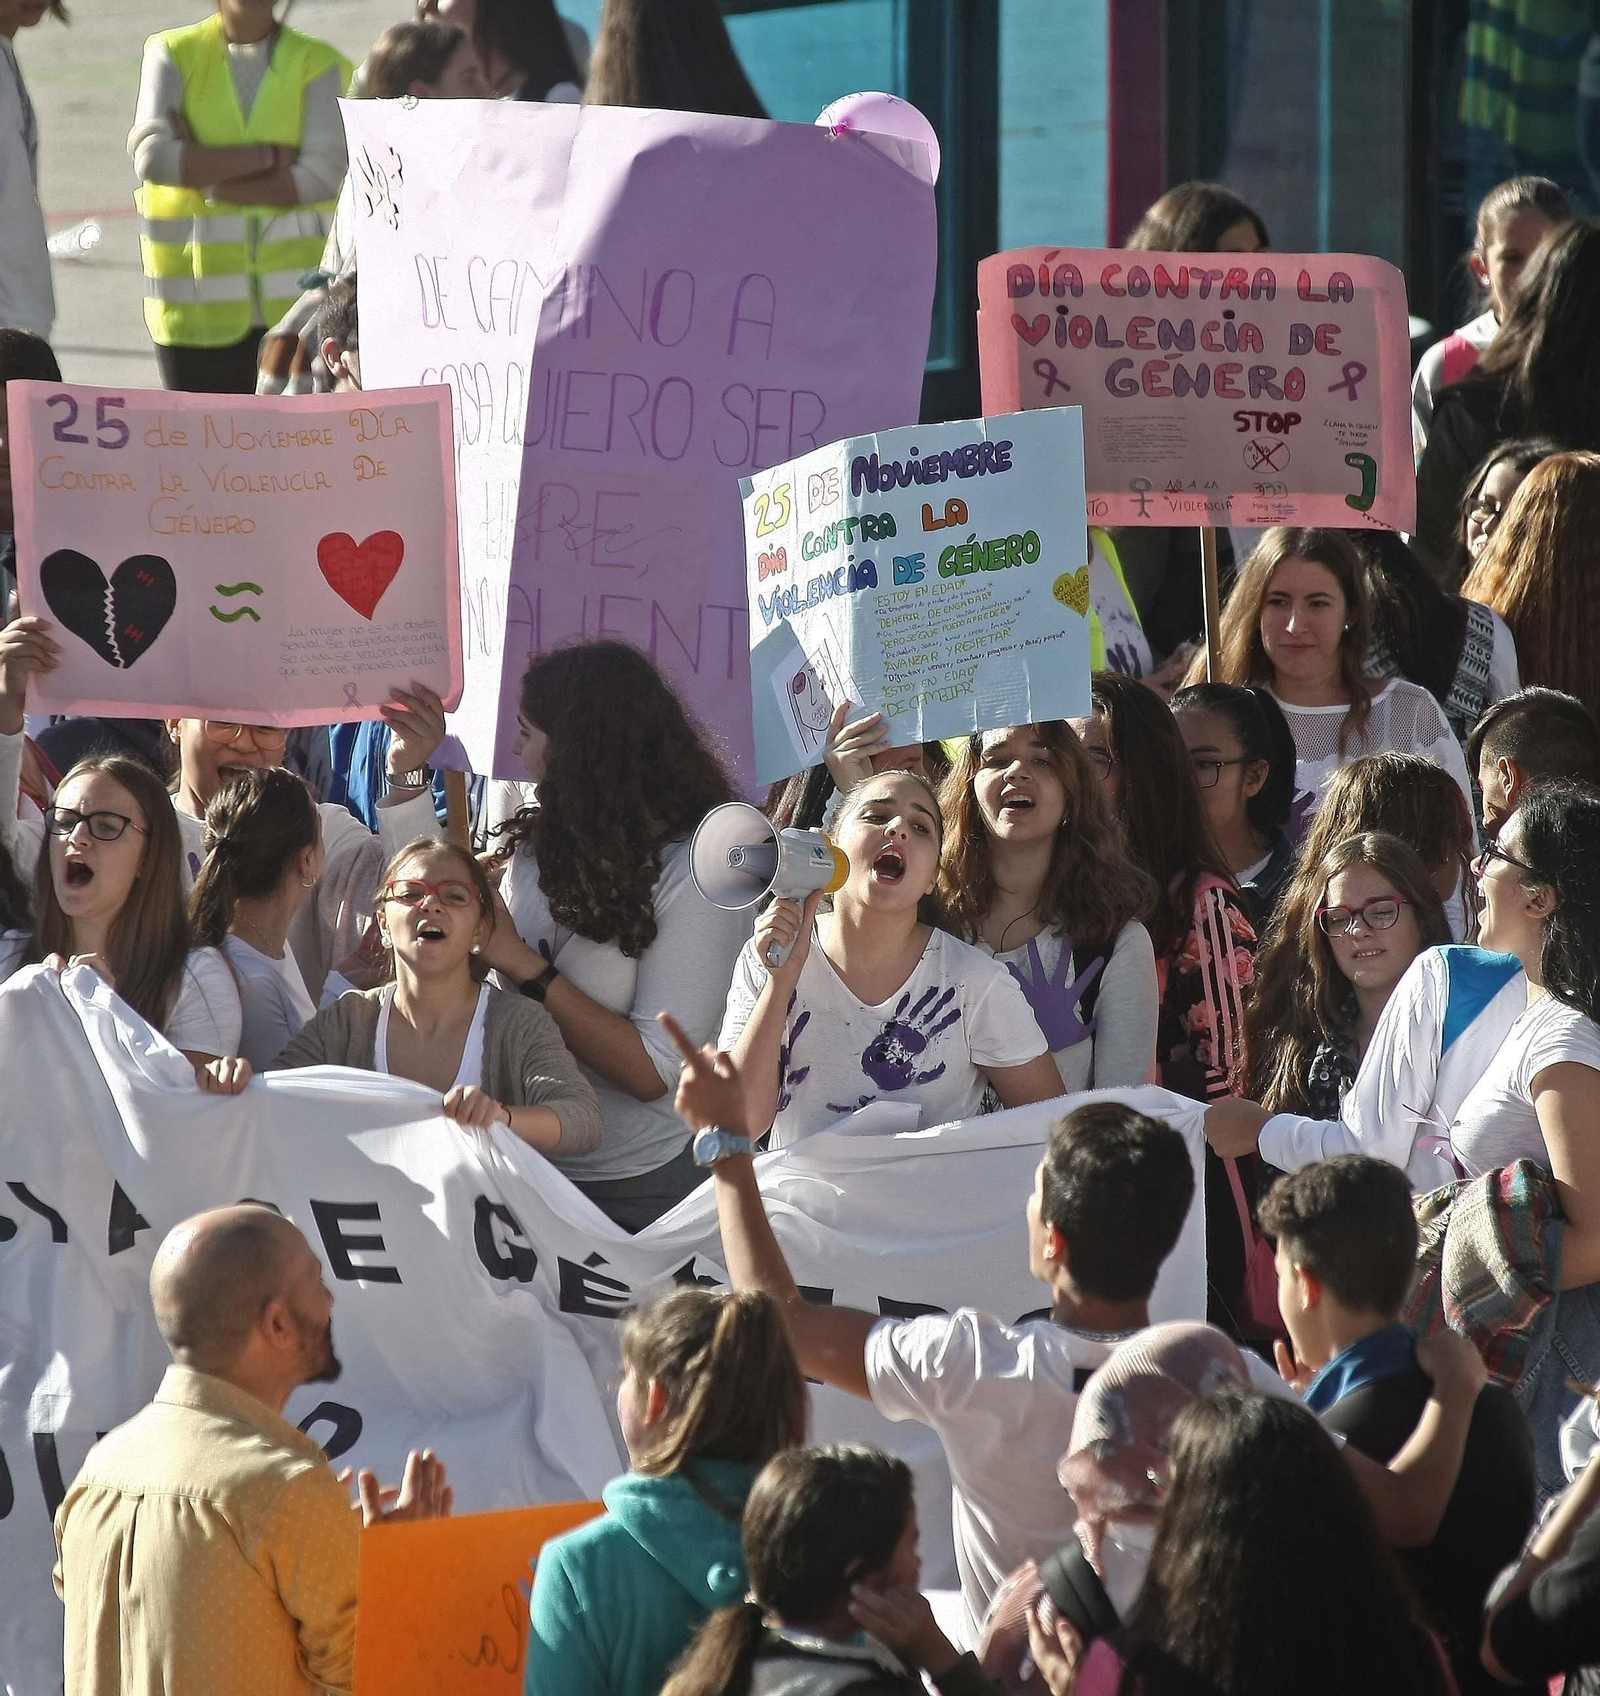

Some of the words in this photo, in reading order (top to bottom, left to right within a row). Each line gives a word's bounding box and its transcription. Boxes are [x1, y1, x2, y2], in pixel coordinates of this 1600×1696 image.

[1006, 250, 1084, 299] DÍA
[1100, 263, 1277, 301] CONTRA
[1297, 269, 1355, 303] LA
[414, 252, 457, 331] DE
[468, 255, 696, 348] CAMINO
[726, 273, 777, 360] A
[1288, 322, 1342, 357] DE
[1105, 353, 1307, 401] GÉNERO
[46, 393, 130, 449] 25
[143, 416, 189, 447] de
[503, 362, 695, 461] QUIERO
[713, 383, 827, 470] SER
[1233, 411, 1302, 434] STOP
[39, 455, 137, 491] CONTRA
[353, 455, 388, 482] DE
[754, 483, 791, 538] 25
[808, 467, 840, 513] DE
[850, 440, 1014, 497] NOVIEMBRE
[1167, 479, 1183, 490] NO
[1188, 481, 1197, 489] A
[147, 497, 256, 535] GÉNERO
[801, 512, 897, 562] CONTRA
[922, 498, 968, 532] LA
[893, 552, 925, 586] DE
[938, 529, 1042, 580] GÉNERO
[915, 587, 928, 598] EN
[921, 676, 937, 687] EN
